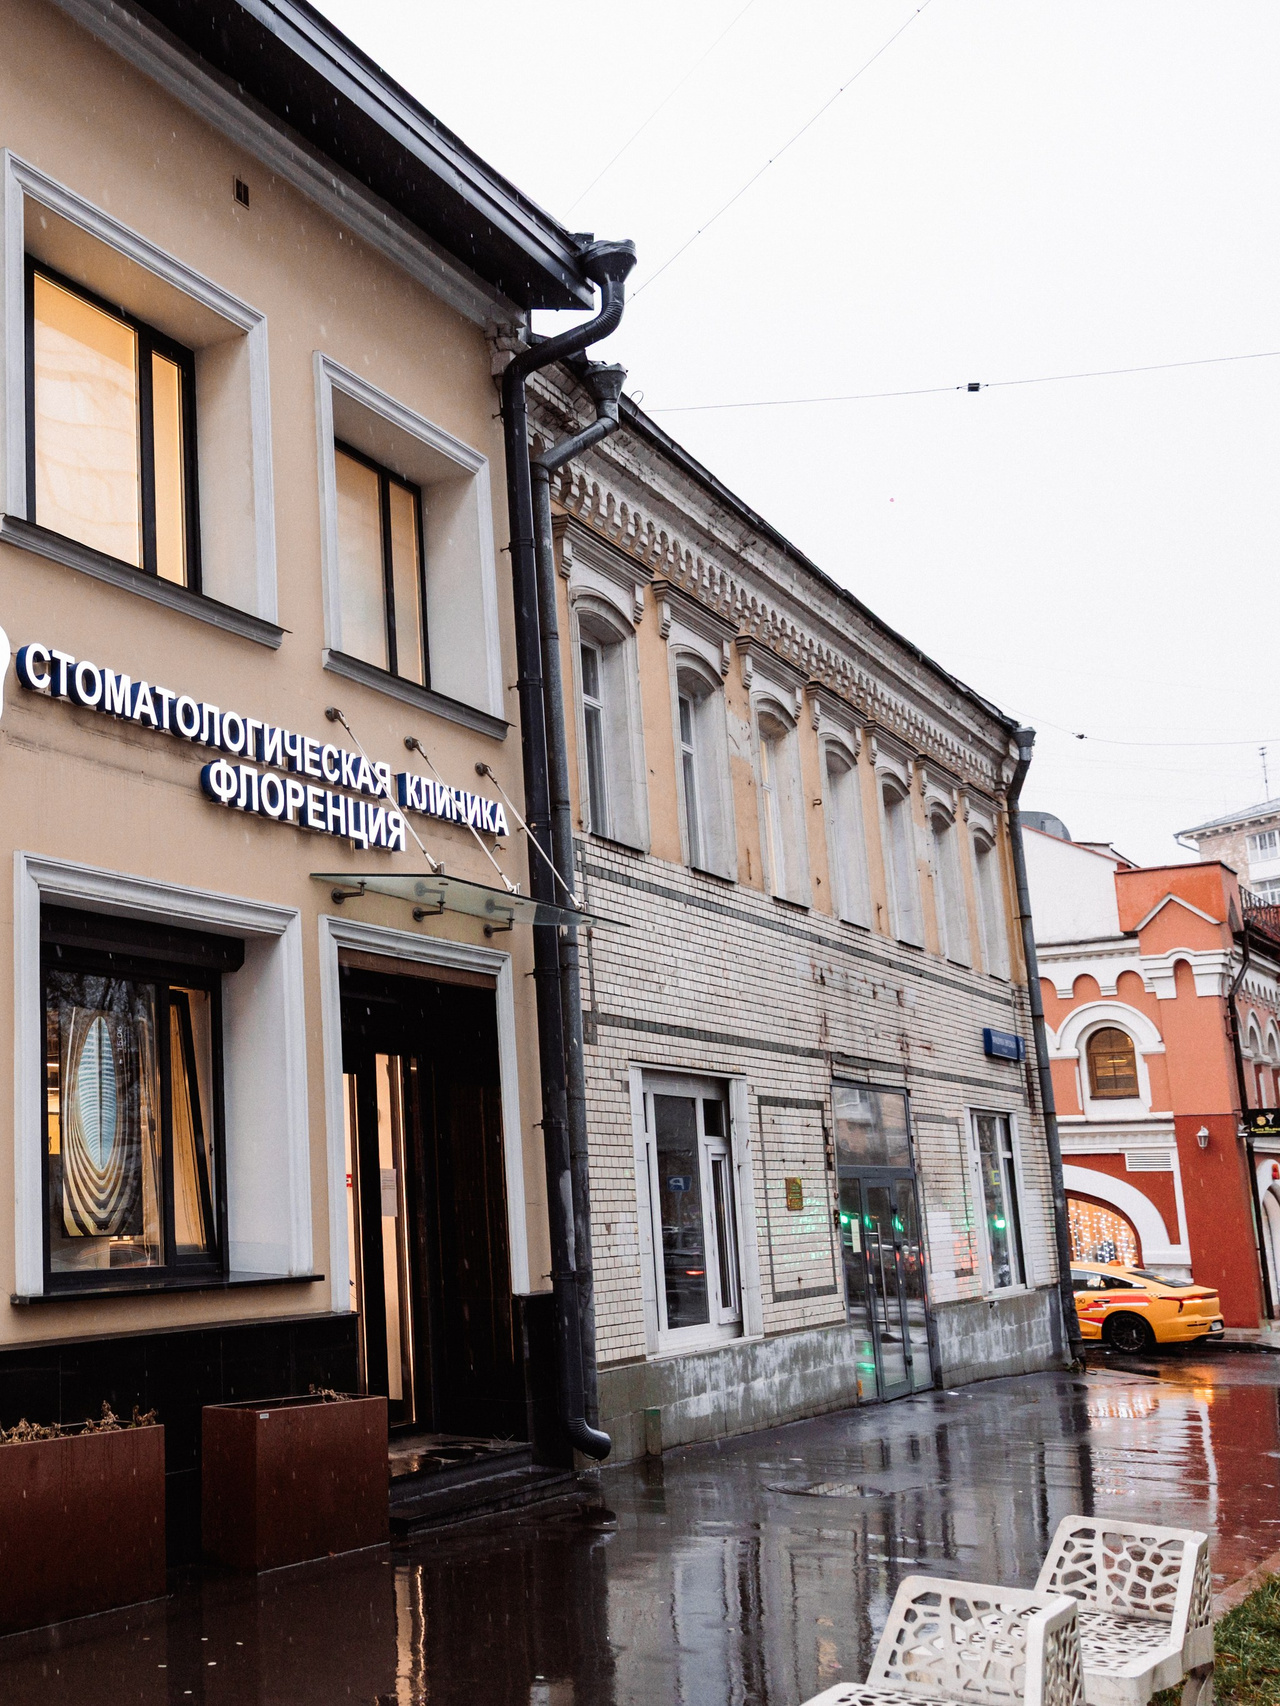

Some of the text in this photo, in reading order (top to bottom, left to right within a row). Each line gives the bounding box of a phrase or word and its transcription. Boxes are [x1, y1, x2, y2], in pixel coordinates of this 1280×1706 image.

[23, 642, 510, 836] СТОМАТОЛОГИЧЕСКАЯ КЛИНИКА
[208, 758, 407, 851] ФЛОРЕНЦИЯ
